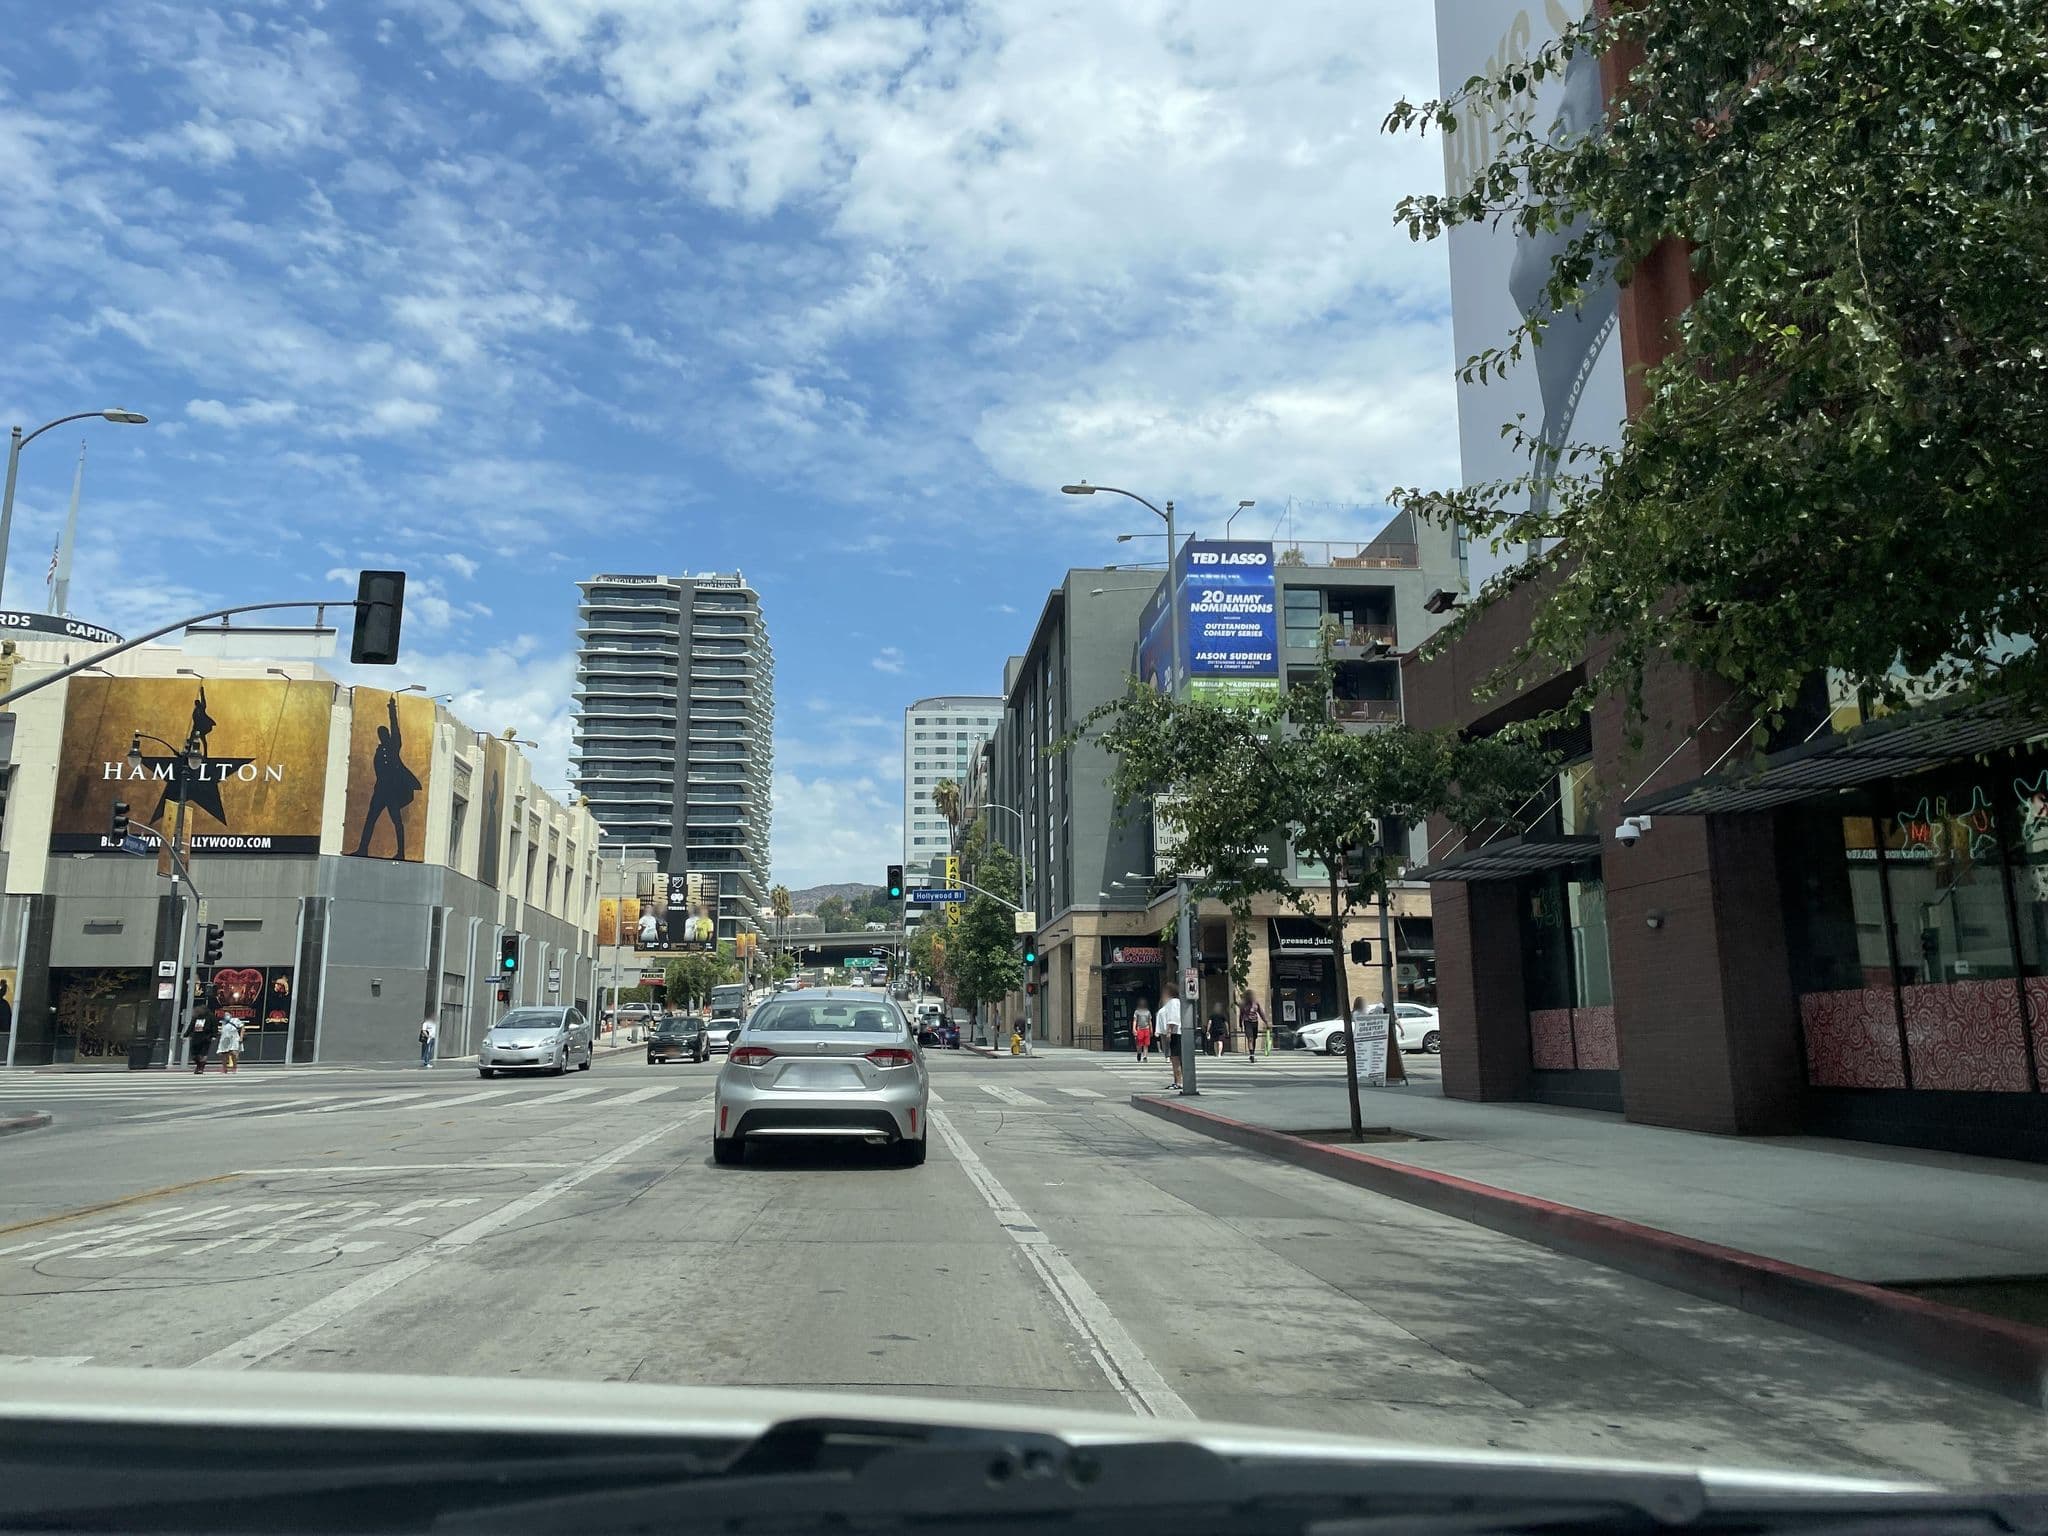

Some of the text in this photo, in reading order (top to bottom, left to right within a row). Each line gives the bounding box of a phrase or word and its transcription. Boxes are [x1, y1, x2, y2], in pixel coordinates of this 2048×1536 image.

[1567, 358, 1591, 409] BOYS
[1589, 311, 1617, 357] STATE
[1192, 552, 1267, 565] TED LASSO
[1201, 590, 1262, 604] 20 EMMY
[1190, 602, 1273, 613] NOMINATIONS
[1195, 652, 1272, 661] JASON SUDEIKIS
[102, 761, 284, 783] HAMLTON
[948, 858, 959, 914] PARKG
[916, 892, 953, 901] Hollywood
[1280, 937, 1313, 945] pressed
